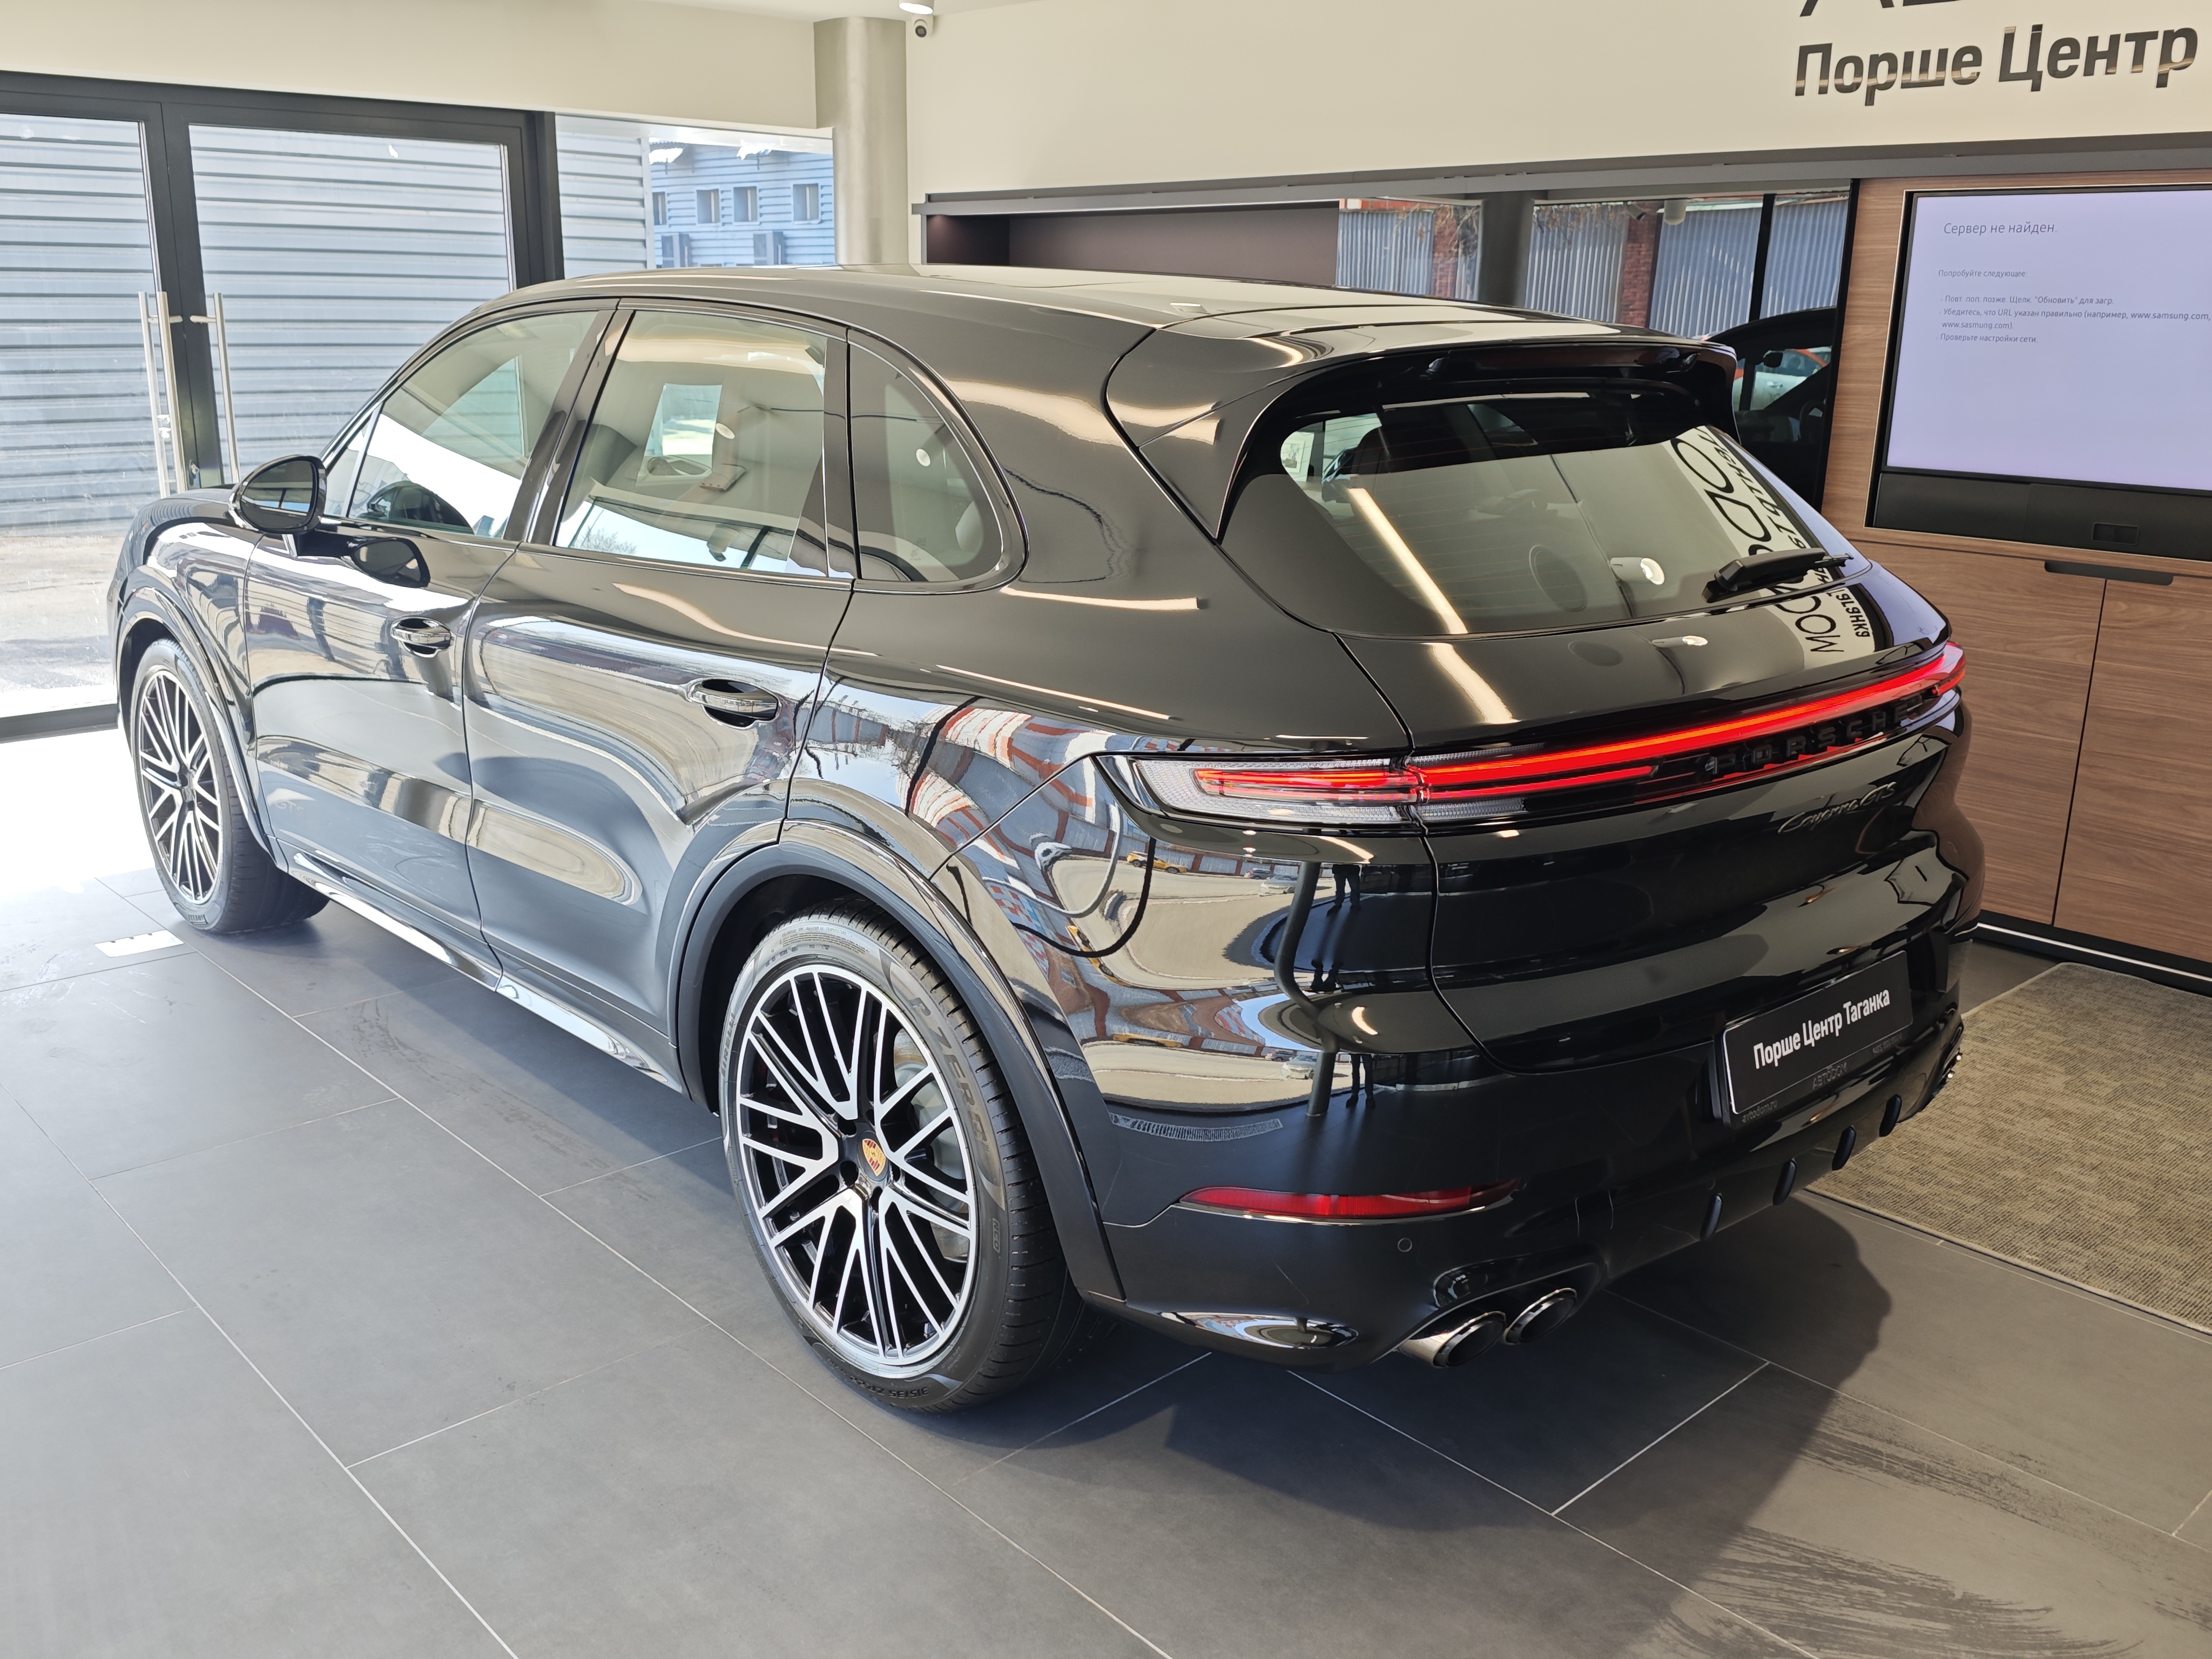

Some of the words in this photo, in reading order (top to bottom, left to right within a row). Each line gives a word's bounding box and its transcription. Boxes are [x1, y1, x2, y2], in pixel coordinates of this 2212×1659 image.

[1795, 43, 1982, 106] Порше
[1998, 24, 2198, 92] Центр
[1944, 222, 1987, 236] Сервер
[1990, 225, 2005, 233] не
[2008, 221, 2058, 234] найден.
[1938, 269, 1982, 278] Попробуйте
[1943, 308, 1982, 316] Убедитесь,
[2084, 310, 2128, 319] (например,
[2130, 313, 2211, 321] www.samsung.com,
[1940, 333, 1978, 342] Проверьте
[1979, 335, 2018, 343] настройки
[1707, 702, 1911, 774] PORSCHE
[275, 800, 307, 819] GTS
[187, 914, 208, 925] PIRELLI
[1753, 1033, 1801, 1069] Порше
[1803, 1011, 1843, 1048] Центр
[1843, 989, 1890, 1025] Таганка
[888, 1386, 929, 1399] 315/35
